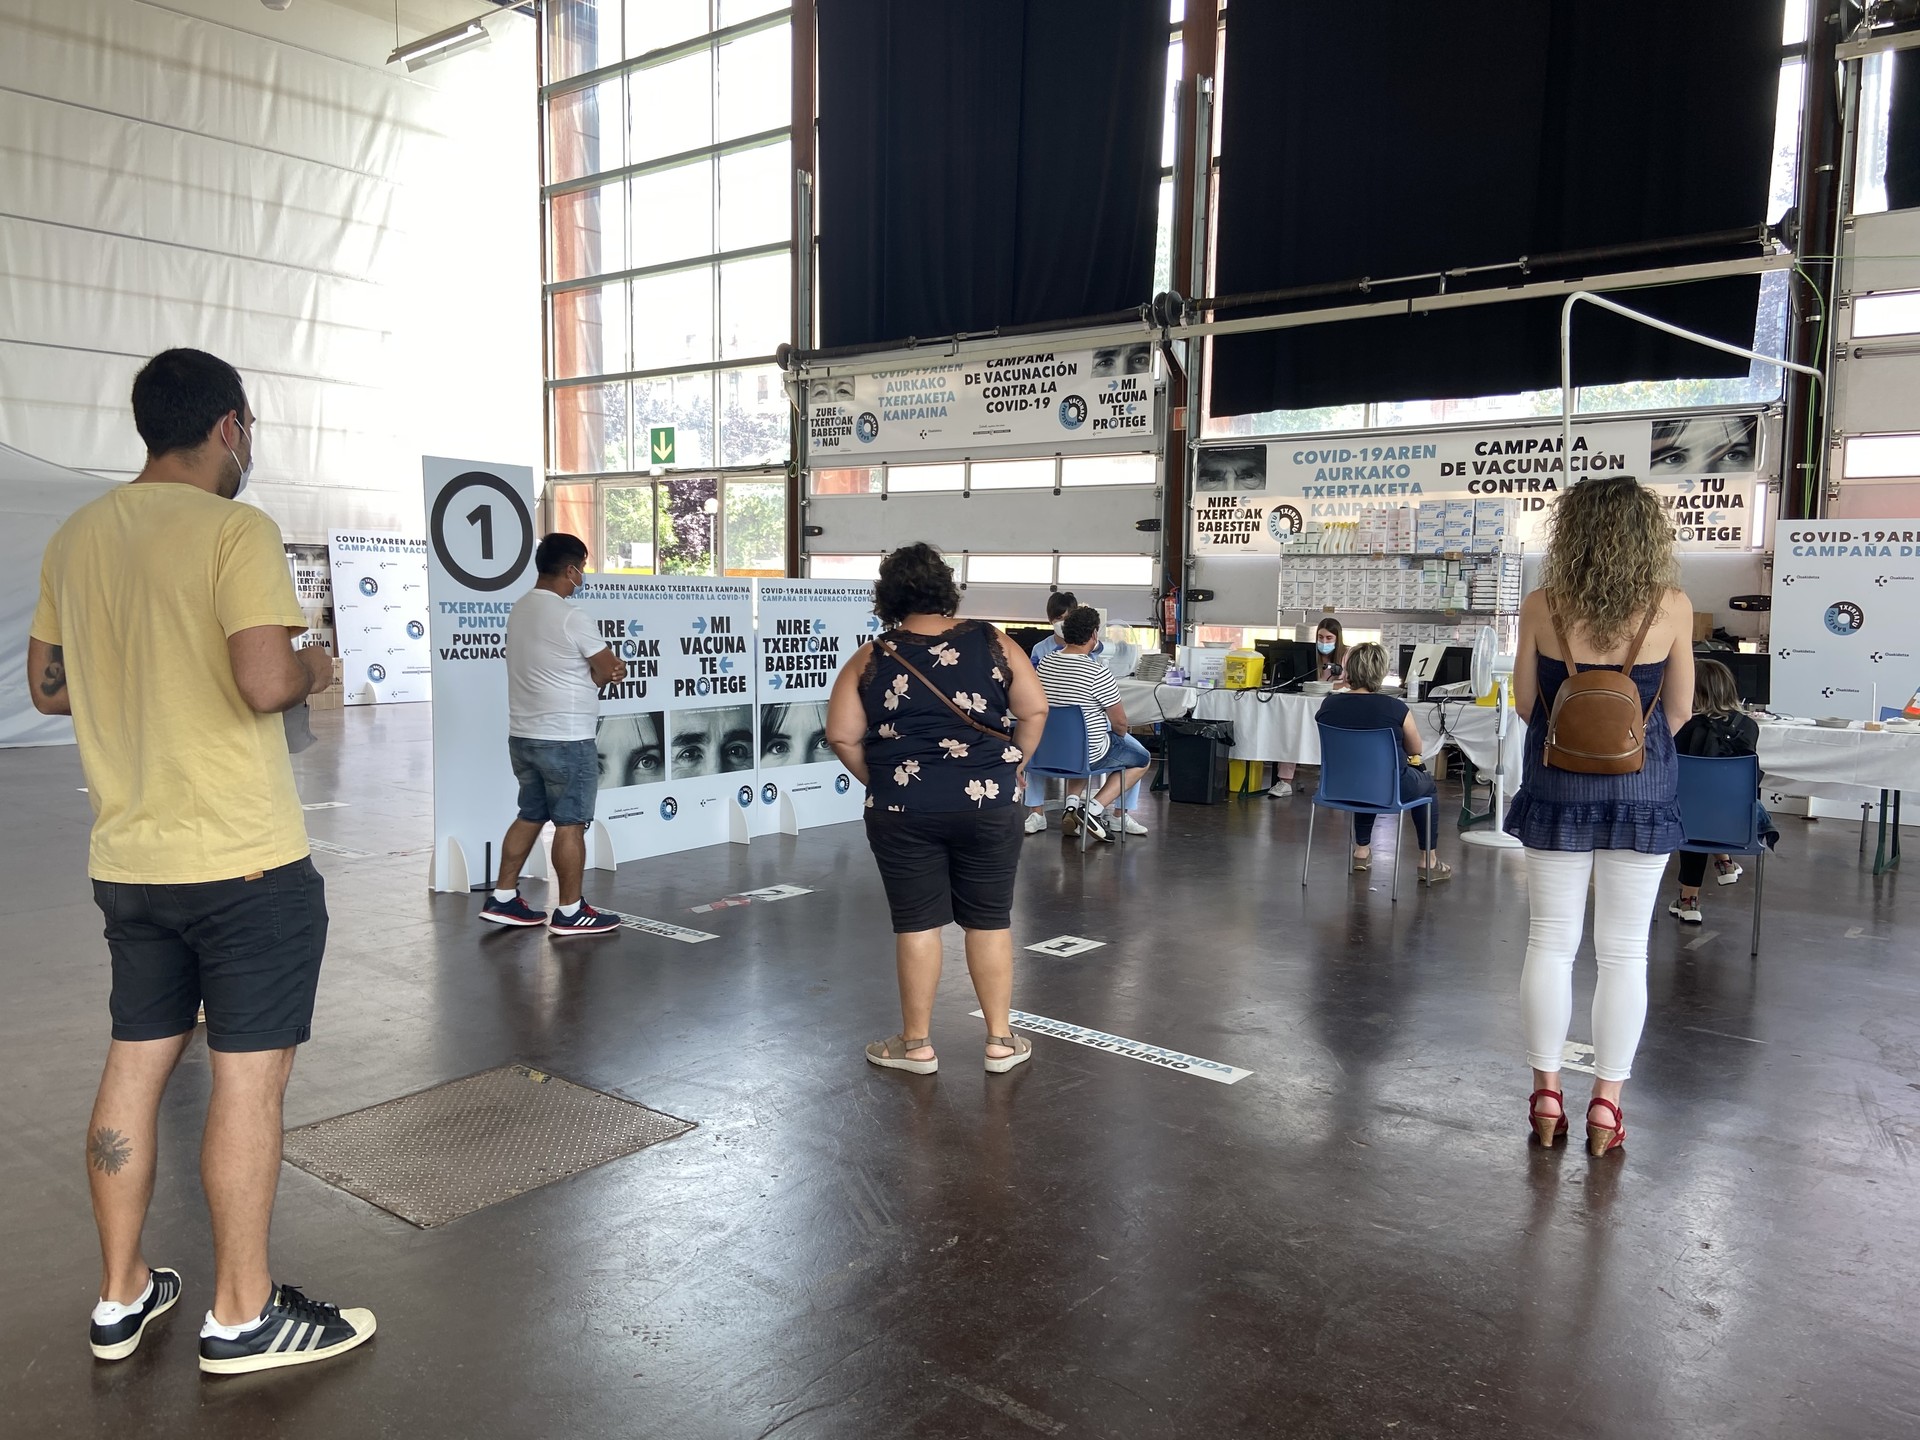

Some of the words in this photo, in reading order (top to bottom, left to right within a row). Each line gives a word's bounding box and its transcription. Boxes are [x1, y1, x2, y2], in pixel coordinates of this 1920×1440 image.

[965, 373, 981, 385] DE
[984, 361, 1077, 383] VACUNACIÓN
[886, 377, 946, 393] AURKAKO
[982, 384, 1036, 399] CONTRA
[1041, 381, 1057, 393] LA
[1121, 378, 1136, 390] MI
[878, 391, 955, 407] TXERTAKETA
[1099, 390, 1147, 404] VACUNA
[816, 407, 837, 416] ZURE
[986, 397, 1050, 413] COVID-19
[1112, 405, 1124, 416] TE
[883, 406, 947, 421] KANPAINA
[810, 416, 853, 427] TXERTOAK
[1093, 415, 1146, 430] PROTEGE
[811, 426, 852, 437] BABESTEN
[822, 437, 840, 447] NAU
[1293, 445, 1436, 465] COVID-19AREN
[1441, 461, 1466, 476] DE
[1472, 451, 1625, 475] VACUNACIÓN
[1315, 464, 1410, 482] AURKAKO
[1302, 482, 1423, 500] TXERTAKETA
[1468, 478, 1557, 494] CONTRA
[1701, 479, 1725, 493] TU
[1208, 497, 1237, 507] NIRE
[1662, 494, 1744, 509] VACUNA
[1197, 508, 1262, 520] TXERTOAK
[1676, 511, 1704, 525] ME
[466, 504, 494, 560] 1
[1198, 521, 1260, 532] BABESTEN
[336, 535, 406, 545] COVID-19AREN
[1213, 534, 1250, 544] ZAITU
[338, 544, 386, 553] CAMPAÑA
[1792, 543, 1892, 557] CAMPAÑA
[628, 584, 666, 592] AURKAKO
[622, 592, 674, 600] VACUNACIÓN
[762, 594, 796, 602] CAMPAÑA
[458, 616, 507, 628] PUNTU
[597, 620, 625, 638] IRE
[711, 616, 730, 634] MI
[776, 620, 810, 635] NIRE
[452, 634, 501, 645] PUNTO
[680, 636, 746, 655] VACUNA
[763, 636, 839, 653] TXERTOAK
[700, 657, 717, 675] TE
[765, 654, 837, 672] BABESTEN
[1417, 657, 1429, 677] 1
[674, 676, 747, 697] PROTEGE
[785, 672, 827, 689] ZAITU
[1010, 1019, 1083, 1040] ESPERE
[1082, 1038, 1113, 1048] SU
[1115, 1046, 1190, 1069] TURNO
[1084, 1031, 1142, 1048] ZURE
[1143, 1046, 1233, 1074] TXANDA
